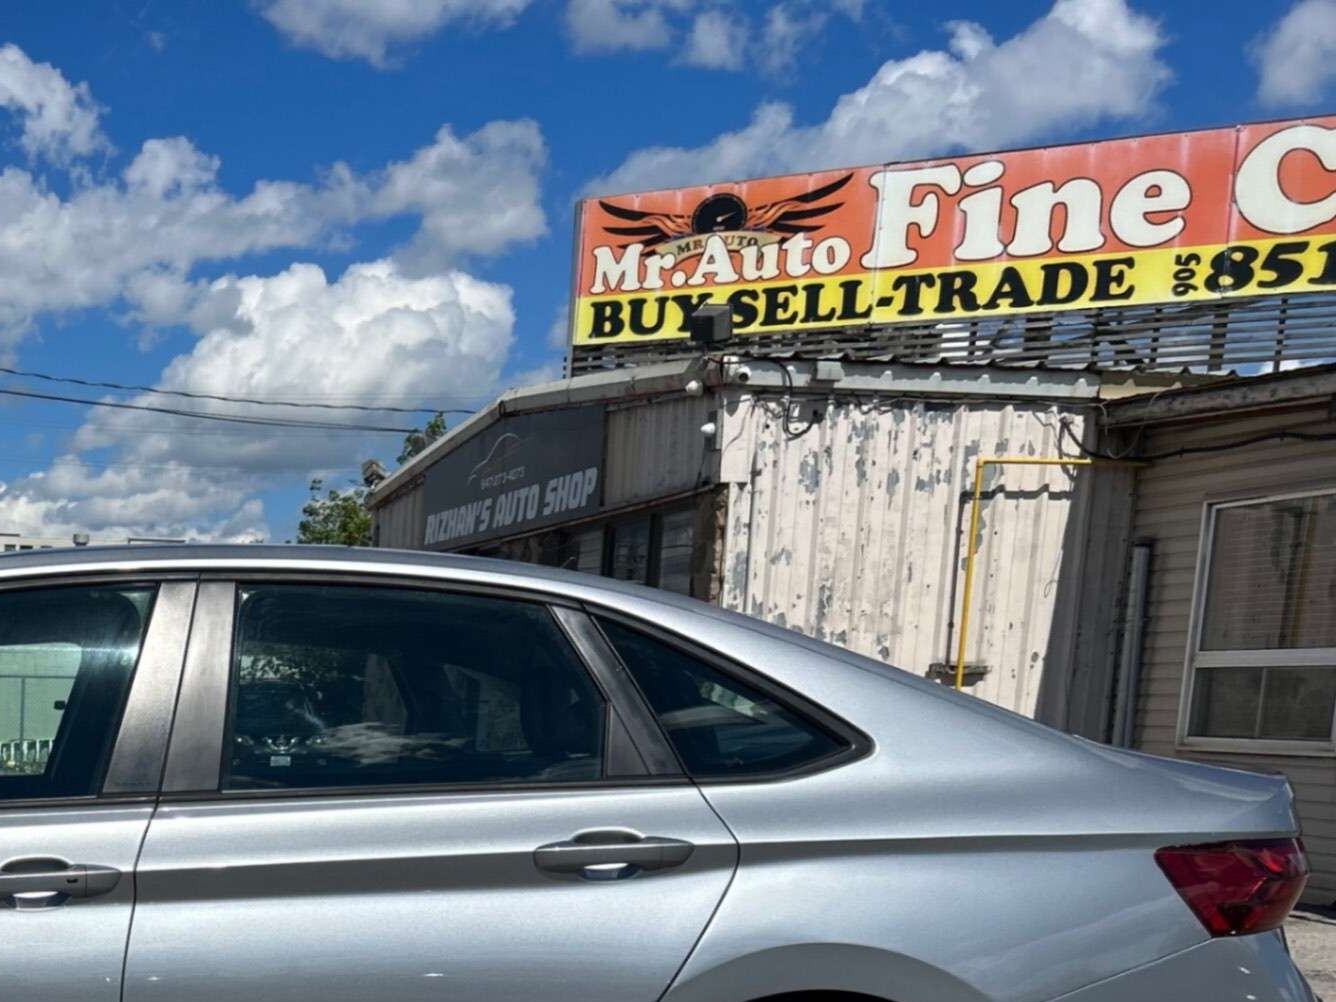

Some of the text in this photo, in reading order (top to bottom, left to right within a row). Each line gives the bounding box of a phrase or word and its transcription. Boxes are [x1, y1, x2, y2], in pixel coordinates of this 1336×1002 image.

[860, 160, 1193, 270] Fine
[1172, 252, 1201, 297] 905
[492, 483, 540, 528] AUTO
[543, 467, 598, 516] SHOP
